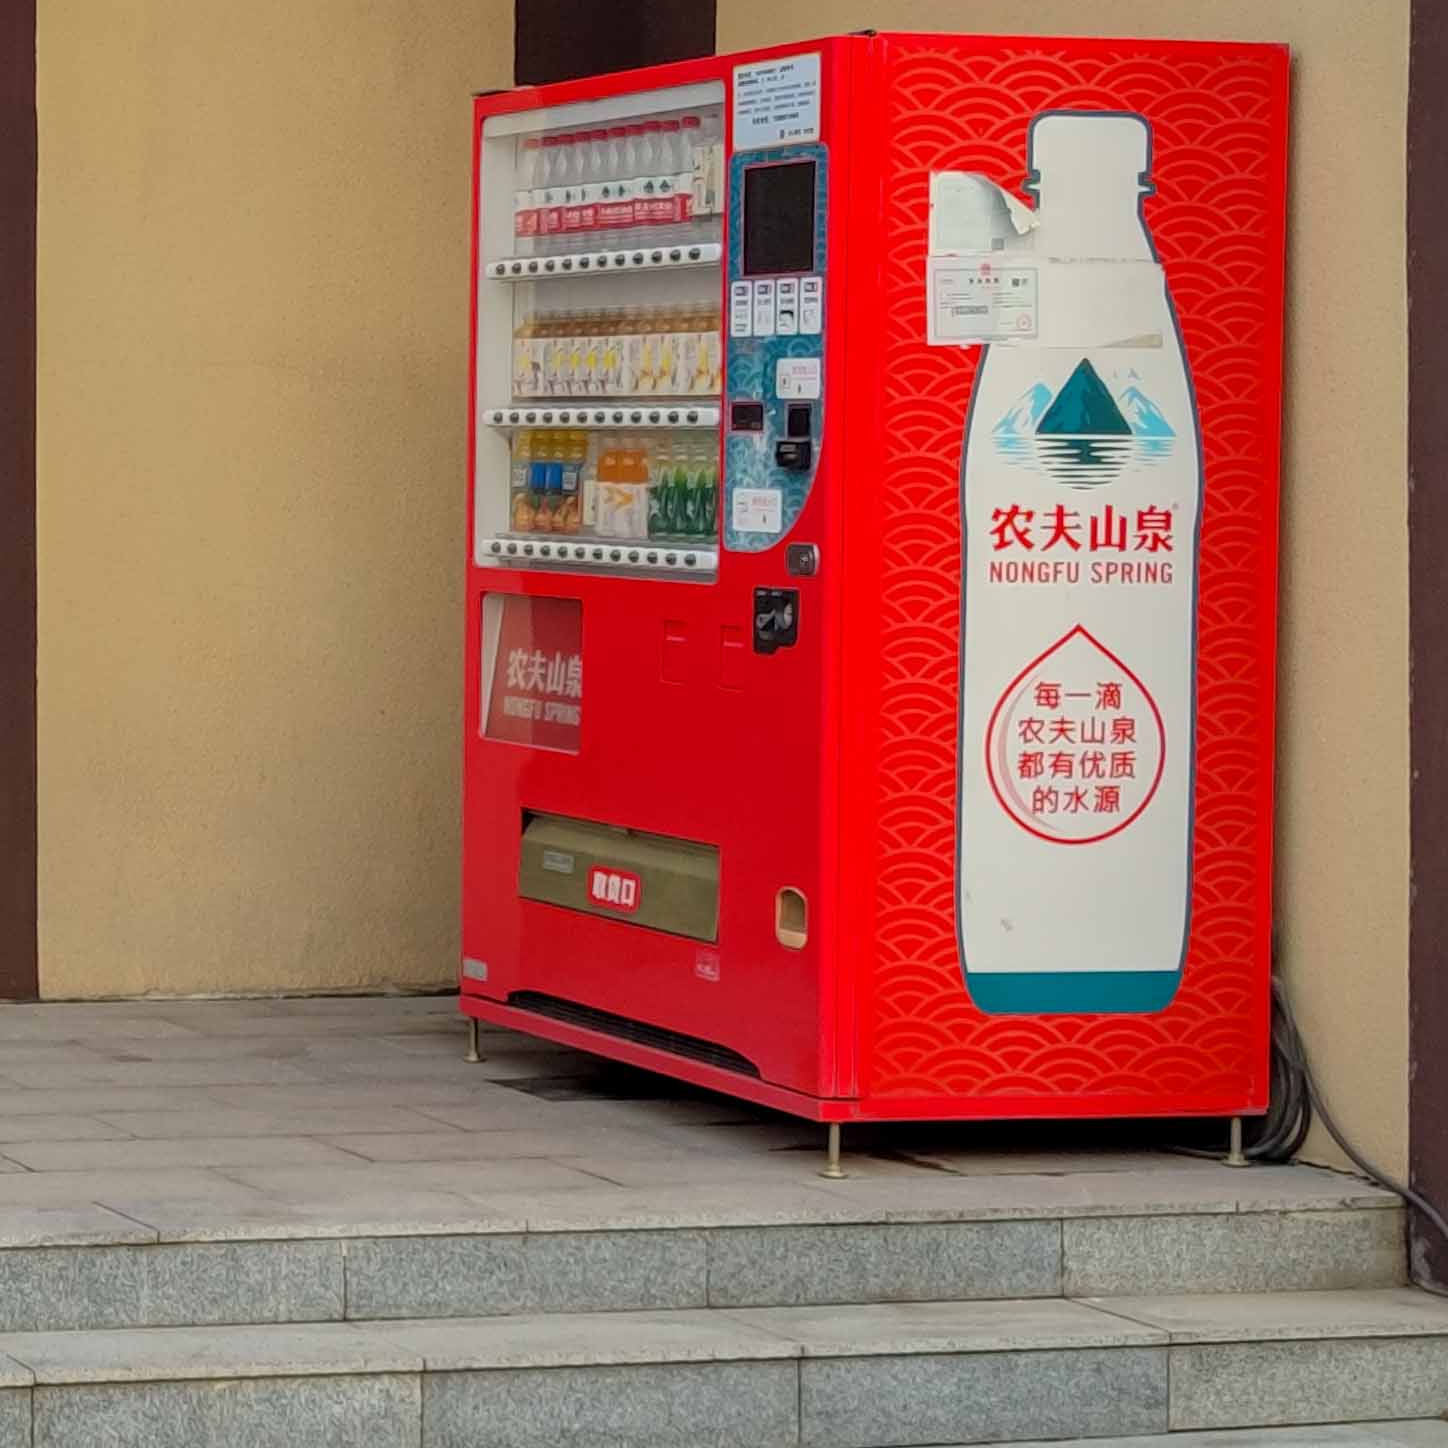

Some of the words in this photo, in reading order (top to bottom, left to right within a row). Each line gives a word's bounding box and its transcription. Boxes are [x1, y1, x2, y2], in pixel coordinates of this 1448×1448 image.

[989, 504, 1174, 552] 农夫山泉
[989, 561, 1080, 584] NONGFU
[1090, 562, 1173, 584] SPRING
[1033, 681, 1122, 710] 每一滴
[1017, 716, 1136, 745] 农夫山泉
[1017, 750, 1136, 780] 都有优质
[1032, 785, 1121, 814] 的水源
